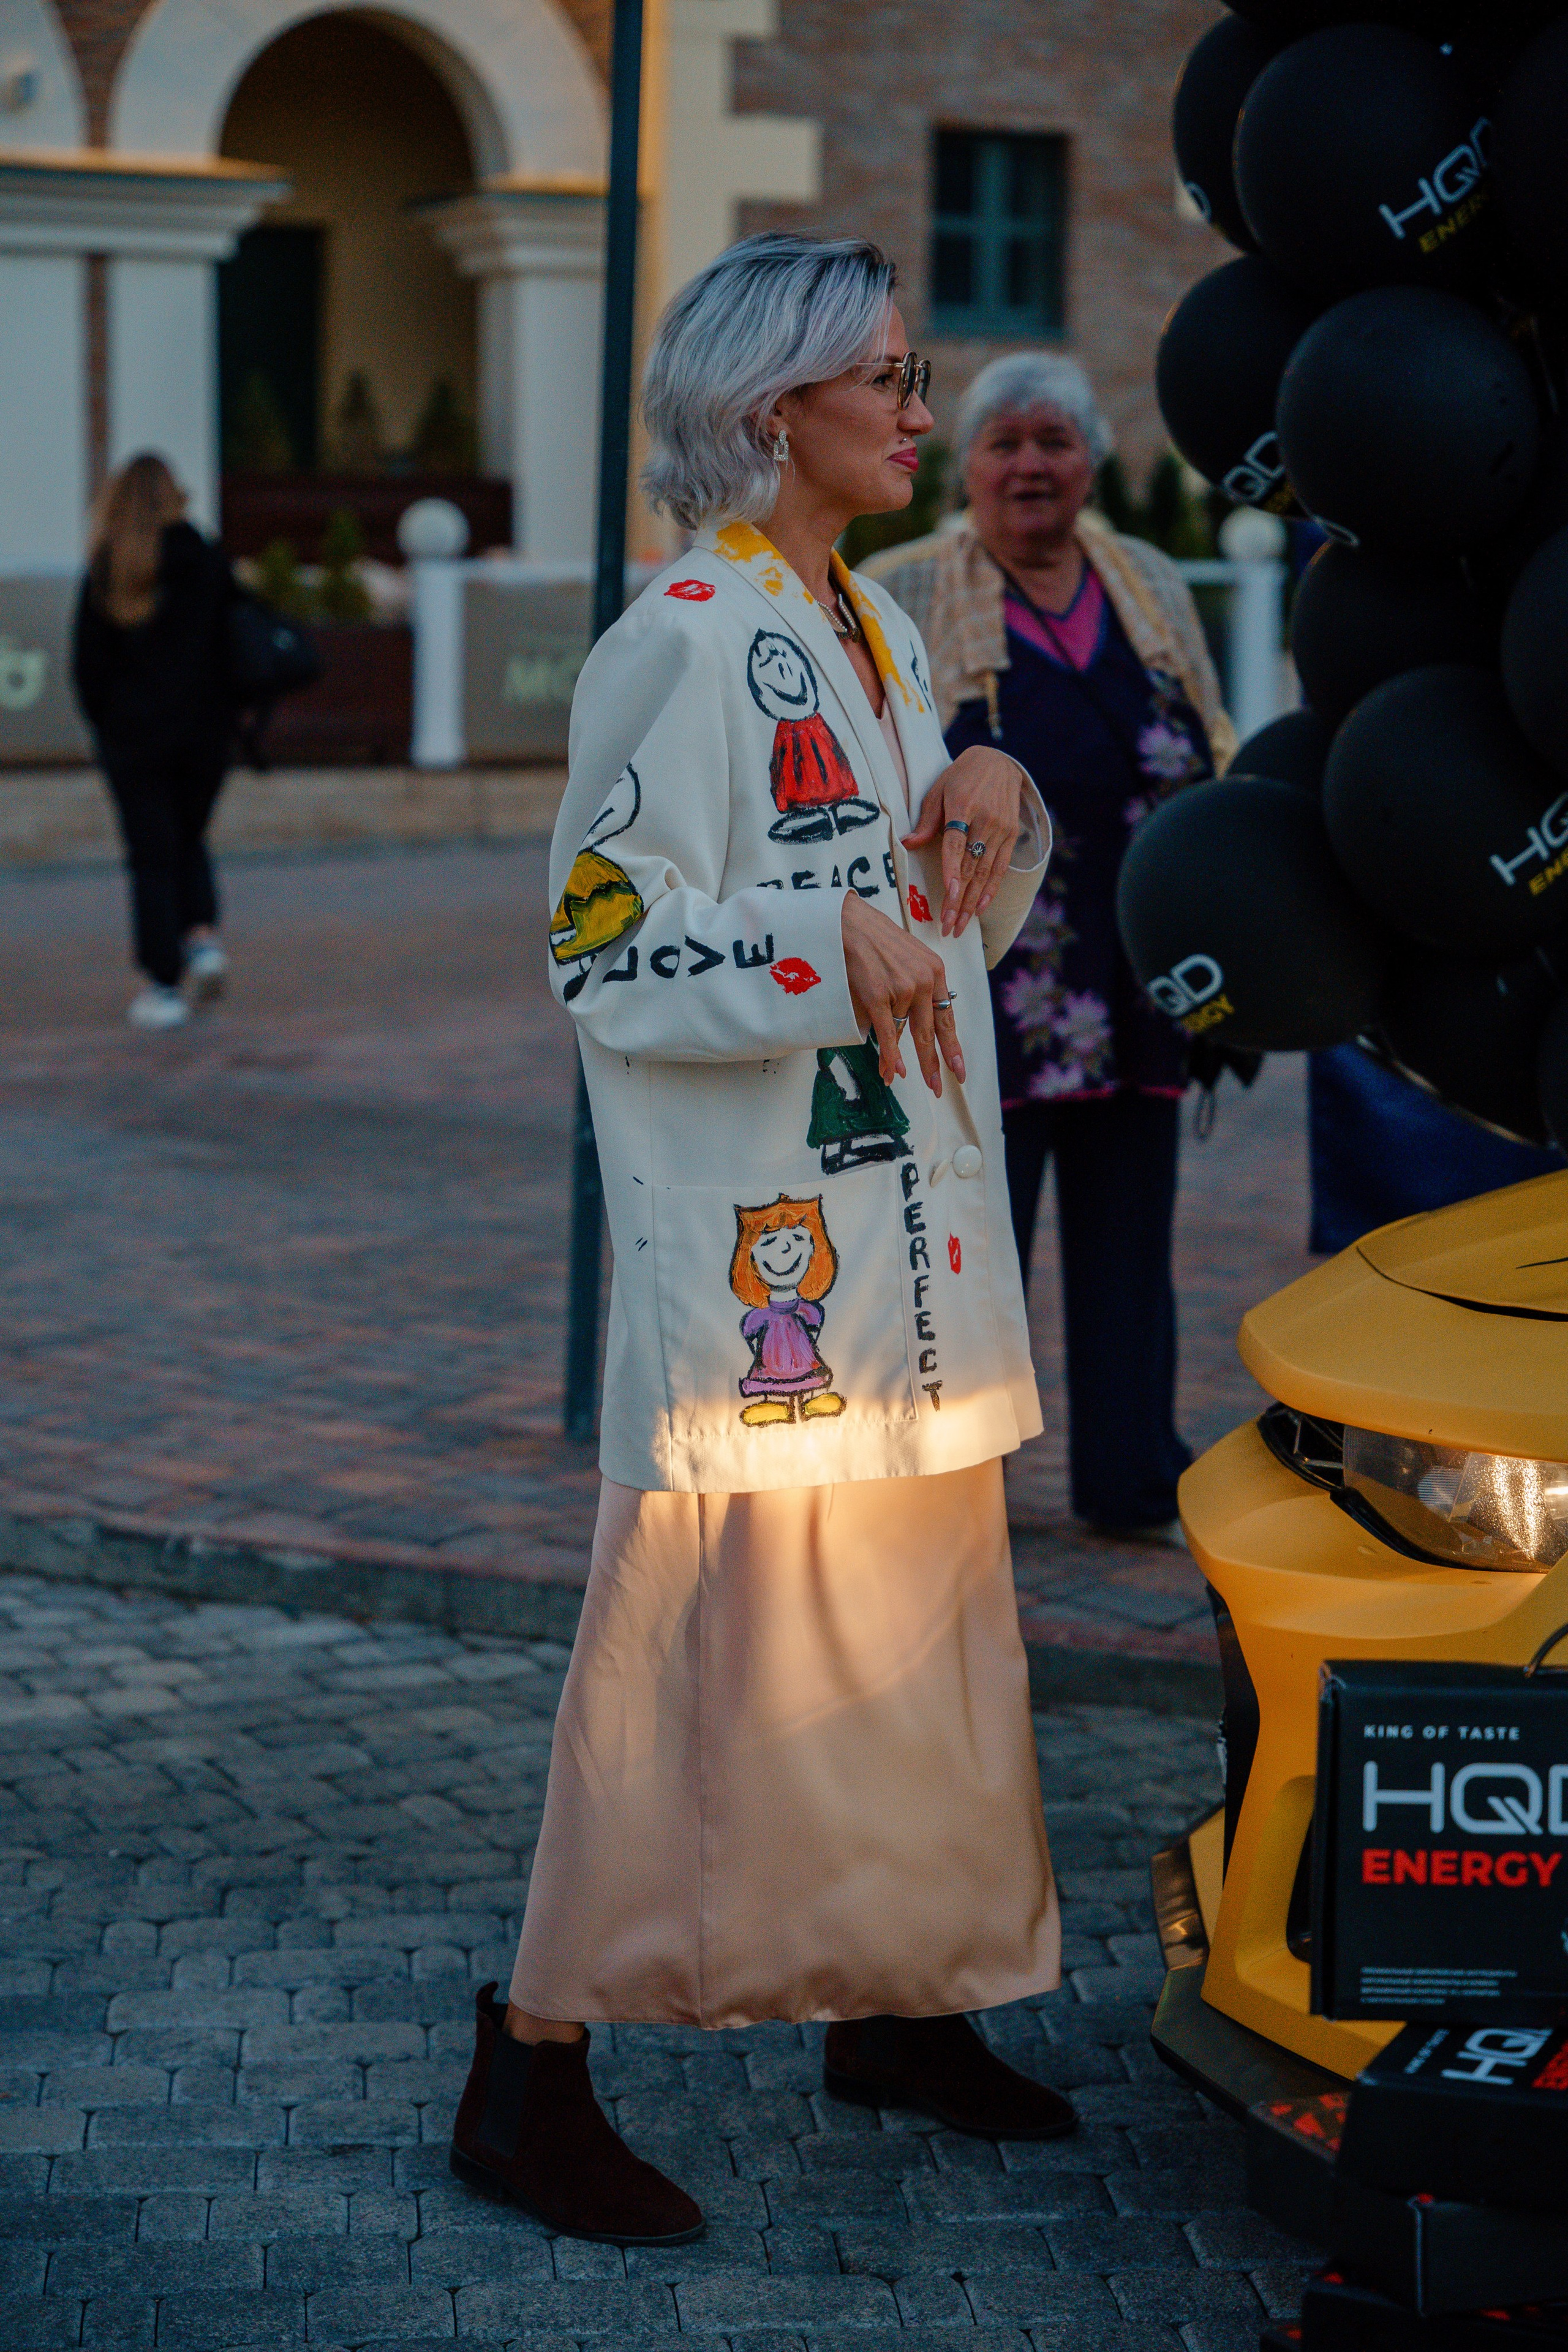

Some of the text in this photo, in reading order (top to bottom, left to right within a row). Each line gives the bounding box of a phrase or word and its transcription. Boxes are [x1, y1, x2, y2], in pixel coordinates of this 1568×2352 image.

[756, 851, 897, 898] EACE
[602, 932, 775, 984] LOVE
[900, 1161, 944, 1412] PERFECT
[1363, 1724, 1520, 1741] KING OF TASTE
[1362, 1760, 1568, 1836] HQ
[1361, 1848, 1562, 1888] ENERGY
